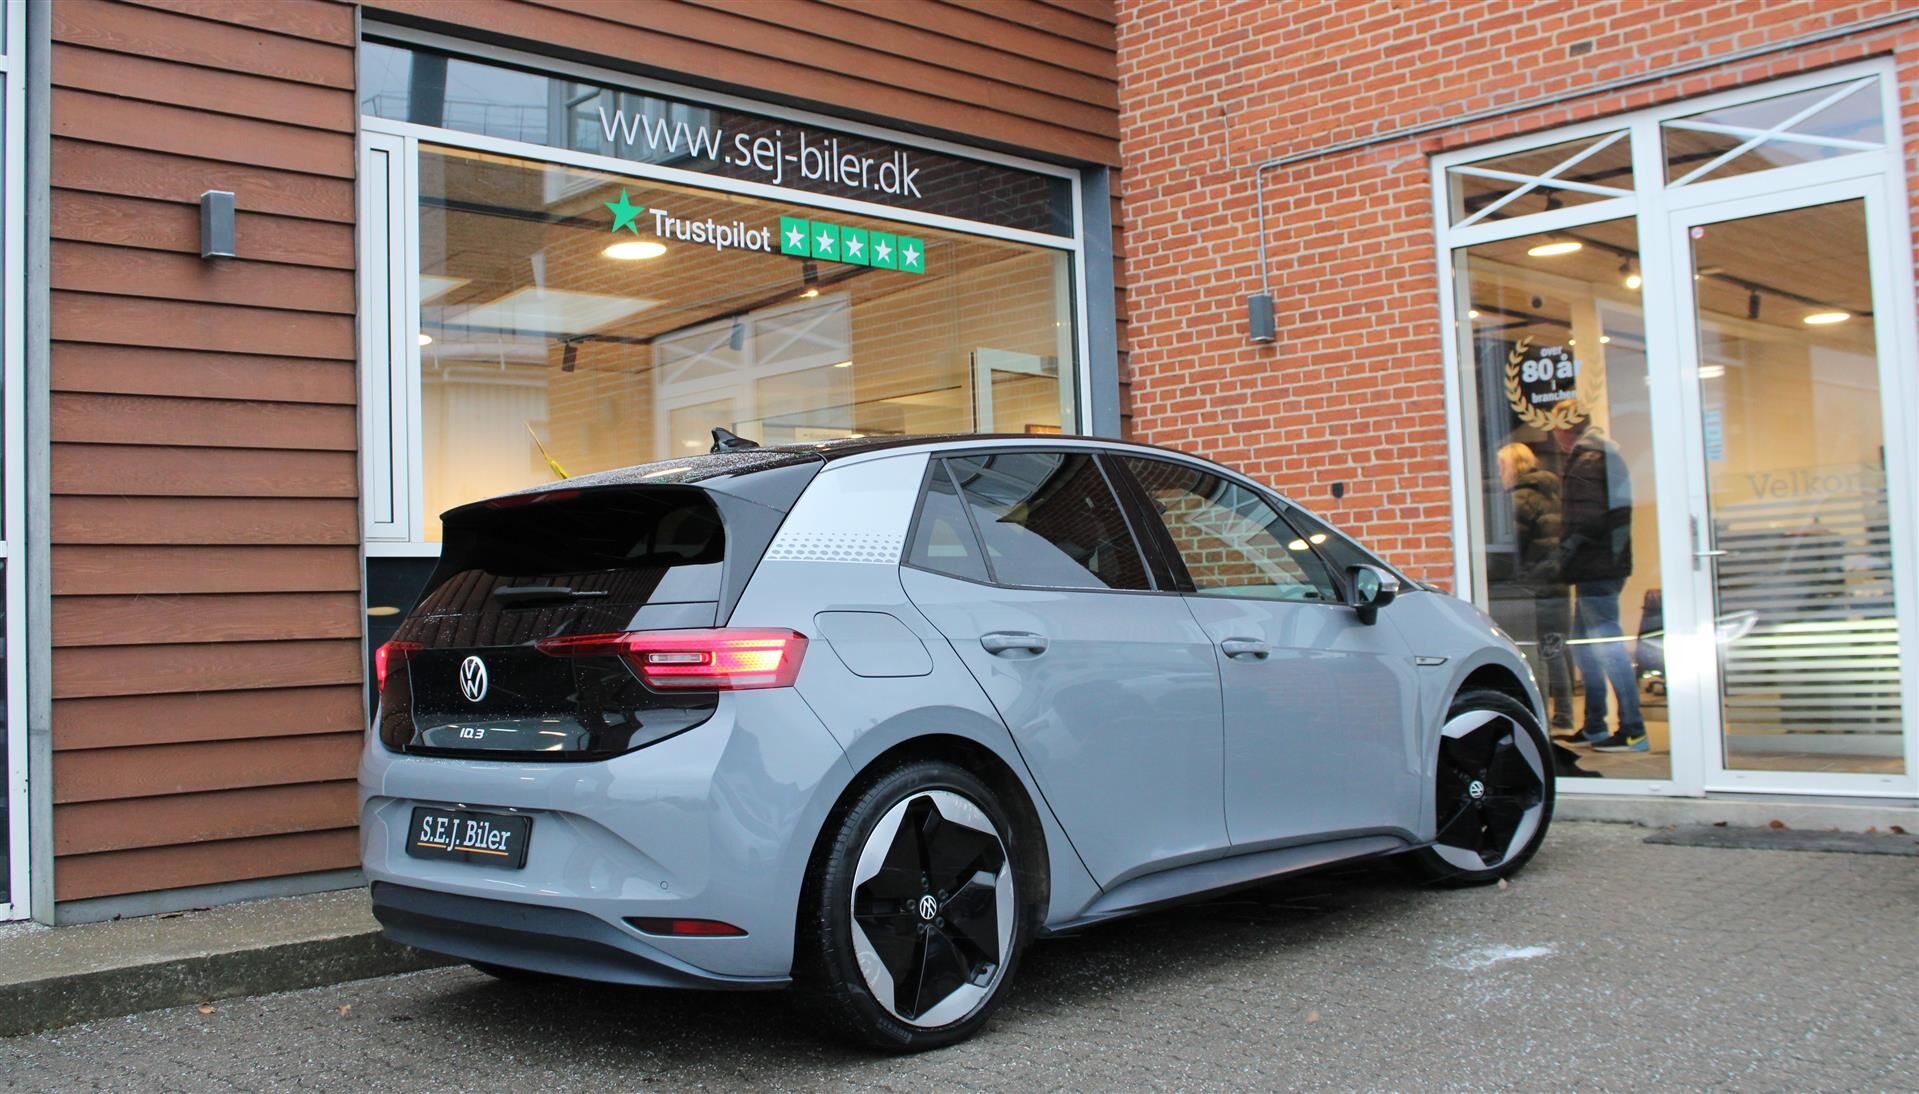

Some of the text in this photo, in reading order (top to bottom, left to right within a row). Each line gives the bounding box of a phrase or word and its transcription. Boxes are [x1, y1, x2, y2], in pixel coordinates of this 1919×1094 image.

[599, 106, 922, 199] www.sej-biler.dk
[649, 208, 771, 251] Trustpilot
[1522, 353, 1584, 383] 80 år
[1540, 346, 1563, 357] over
[420, 816, 511, 852] S.E.J. Biler
